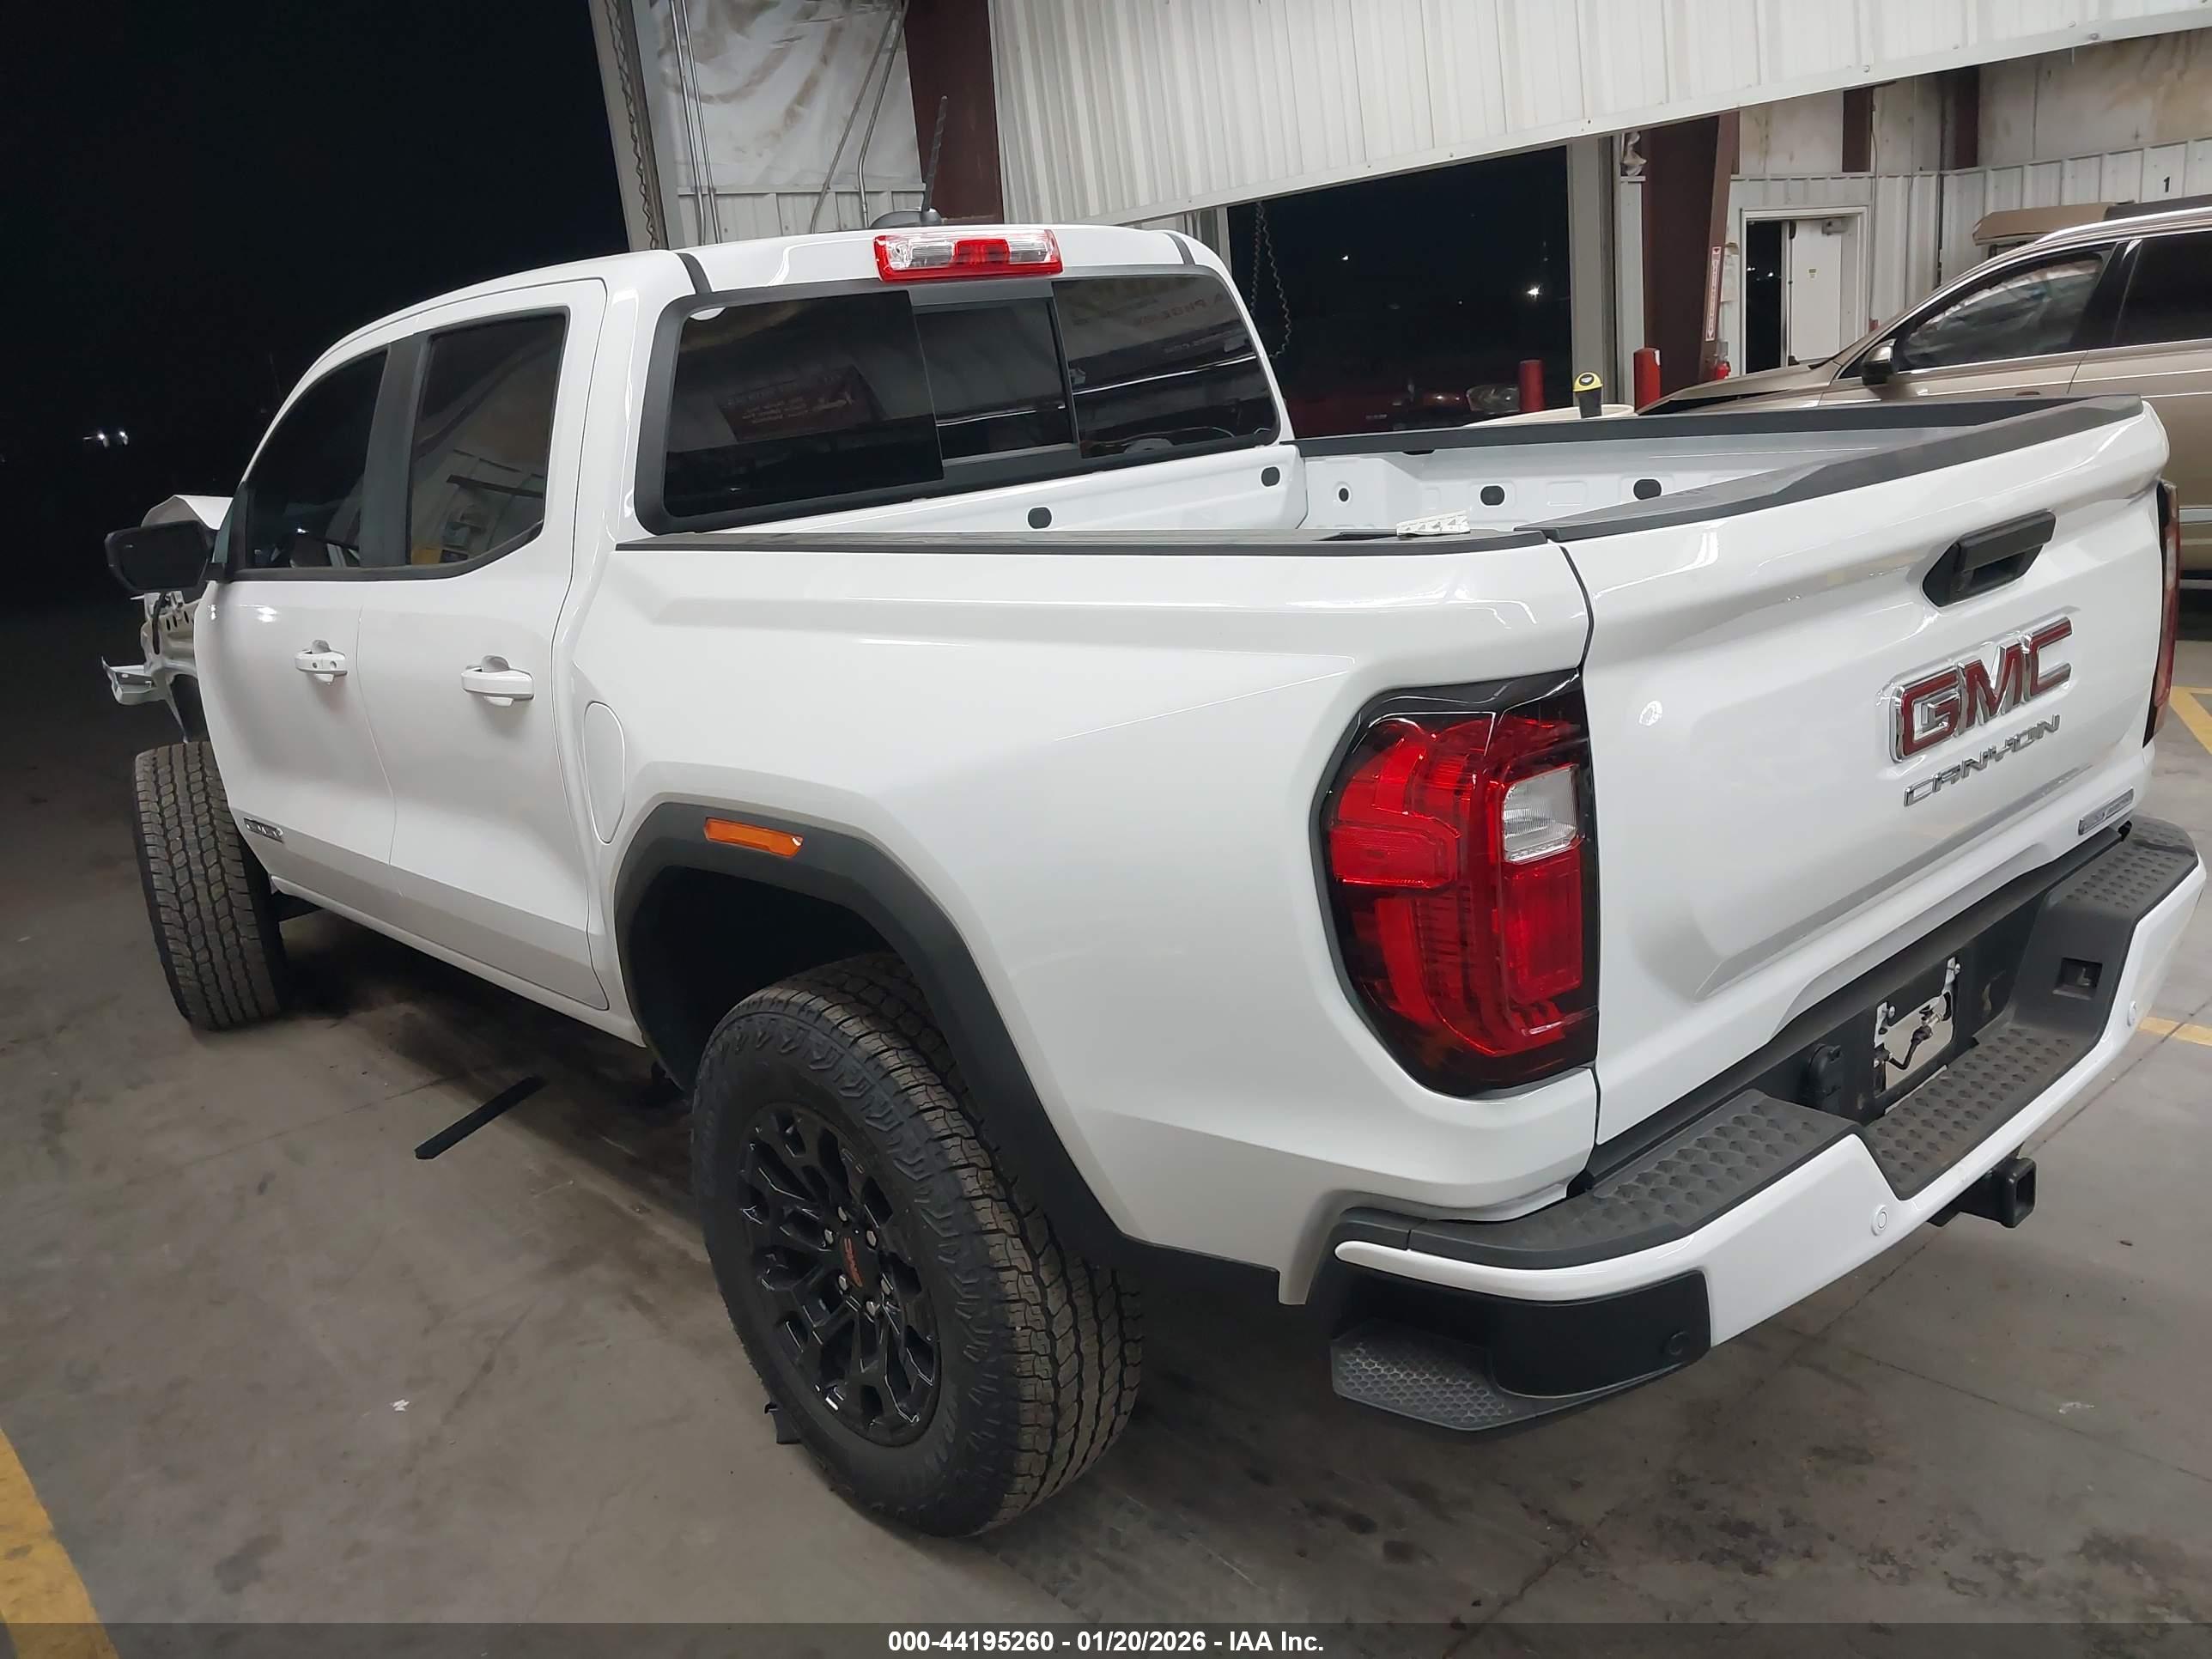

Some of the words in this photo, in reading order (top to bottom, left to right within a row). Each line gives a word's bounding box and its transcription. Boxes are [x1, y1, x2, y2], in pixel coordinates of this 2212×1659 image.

[2164, 176, 2171, 193] 1
[1889, 617, 2073, 763] GMC
[1903, 714, 2061, 807] CANYON
